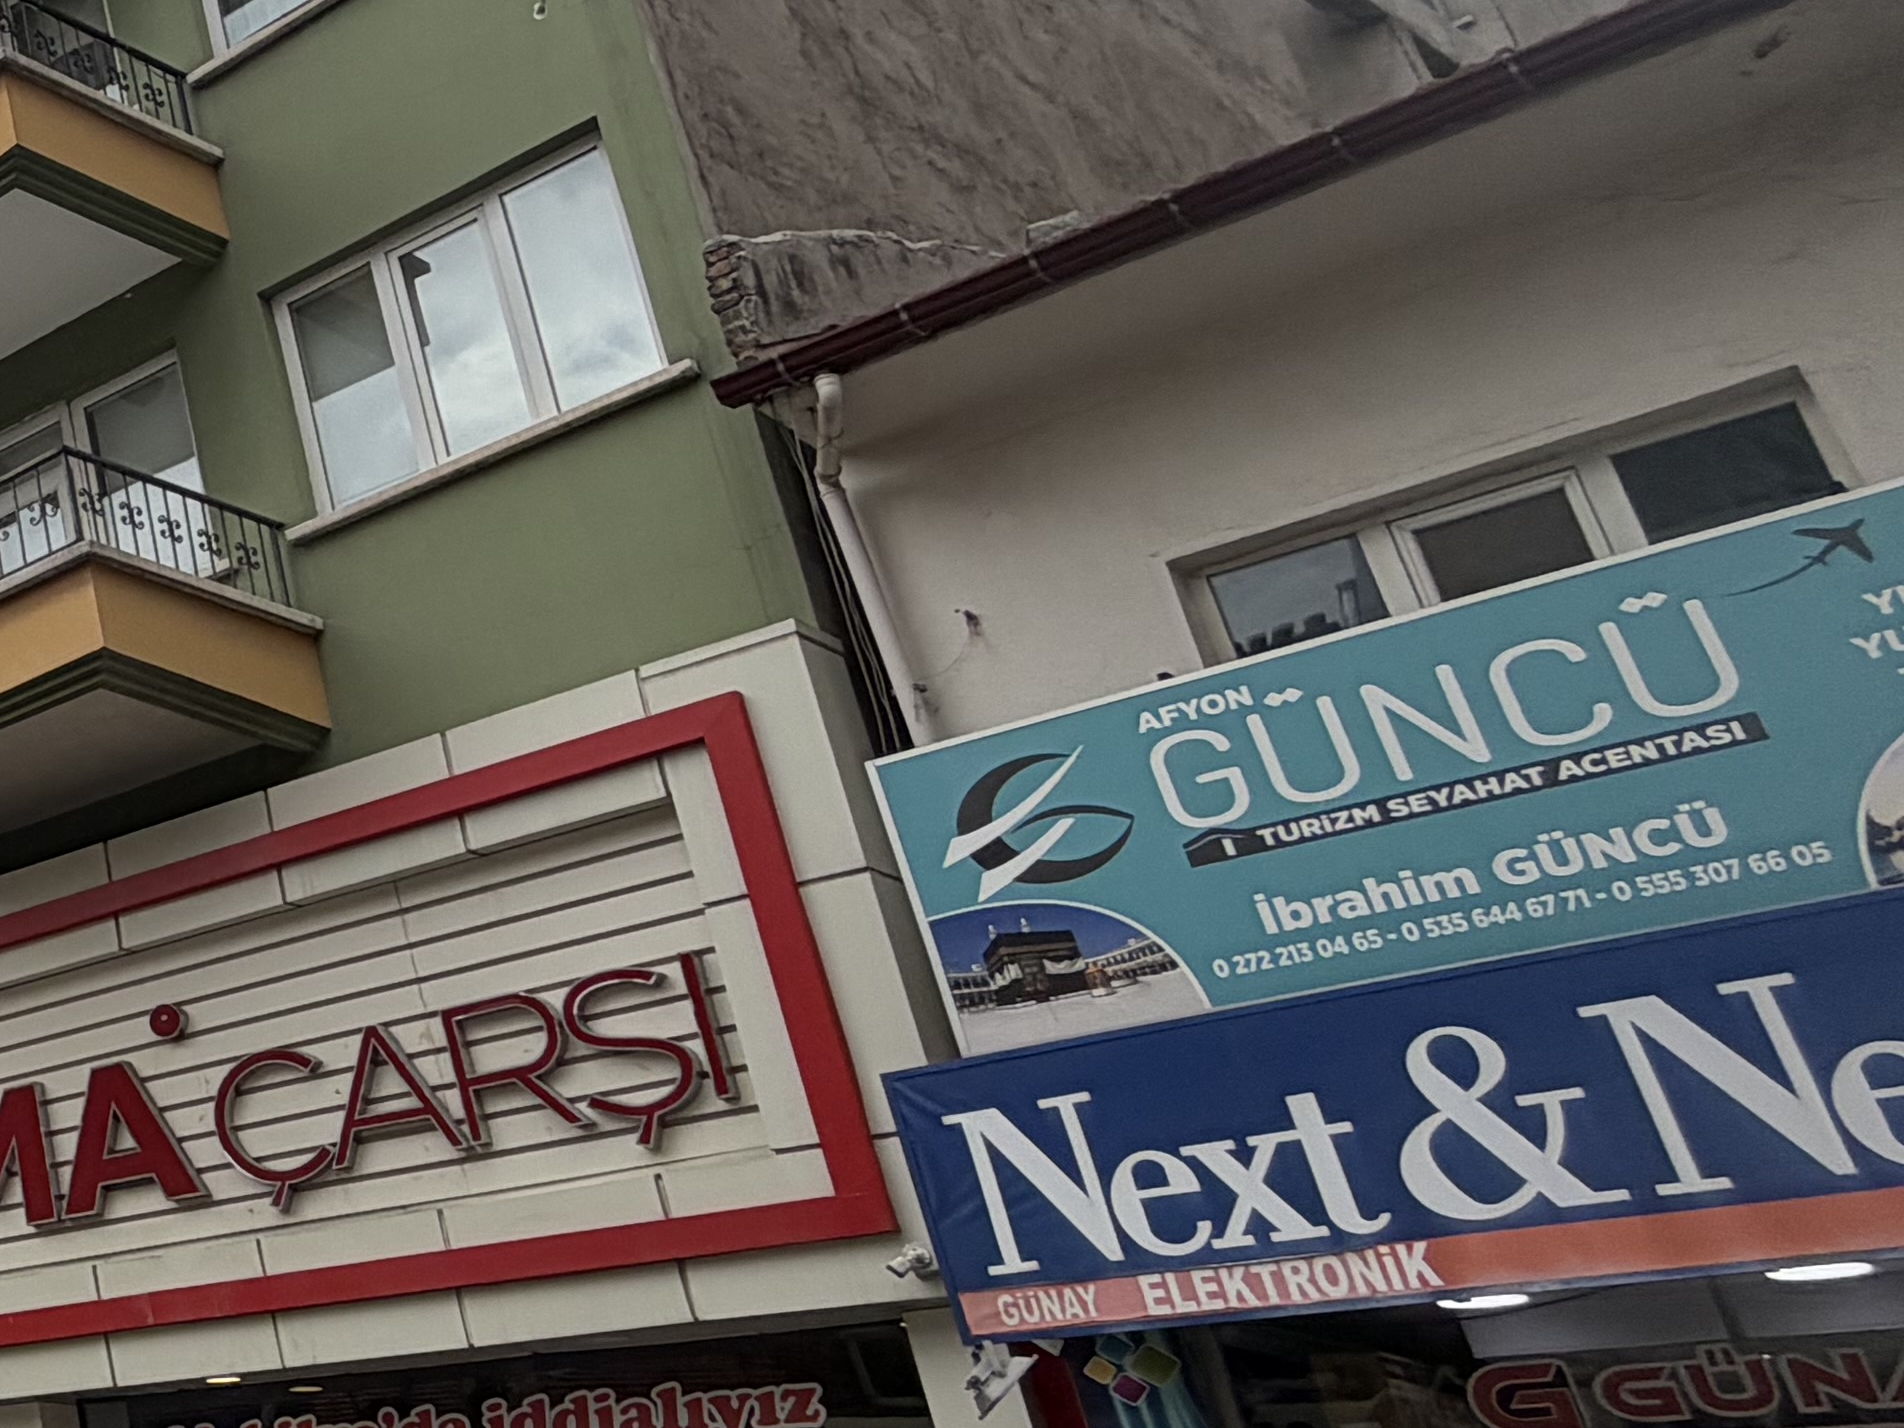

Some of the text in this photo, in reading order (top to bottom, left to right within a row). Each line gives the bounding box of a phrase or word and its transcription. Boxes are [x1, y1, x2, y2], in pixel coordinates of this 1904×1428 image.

[1137, 685, 1255, 734] AFYON
[1149, 590, 1741, 830] GÜNCÜ
[1385, 765, 1546, 819] SEYAHAT
[1556, 719, 1748, 781] ACENTASI
[1212, 957, 1231, 979] 0
[1231, 949, 1273, 975] 272
[1273, 941, 1314, 966] 213
[1315, 934, 1350, 960] 04
[1351, 926, 1385, 952] 65
[1399, 920, 1421, 943] 0
[1425, 910, 1470, 939] 535
[1470, 900, 1524, 929] 644
[1525, 892, 1557, 918] 67
[1557, 886, 1592, 912] 71
[1610, 878, 1633, 903] 0
[1635, 868, 1688, 899] 555
[1690, 857, 1742, 889] 307
[1746, 848, 1788, 875] 66
[1790, 840, 1833, 867] 05
[1252, 799, 1729, 935] İbrahim GÜNCÜ
[213, 951, 739, 1214] ÇARŞI
[940, 1089, 1392, 1279] Next
[1398, 1024, 1633, 1224] &
[994, 1240, 1446, 1332] GÜNAY ELEKTRONİK
